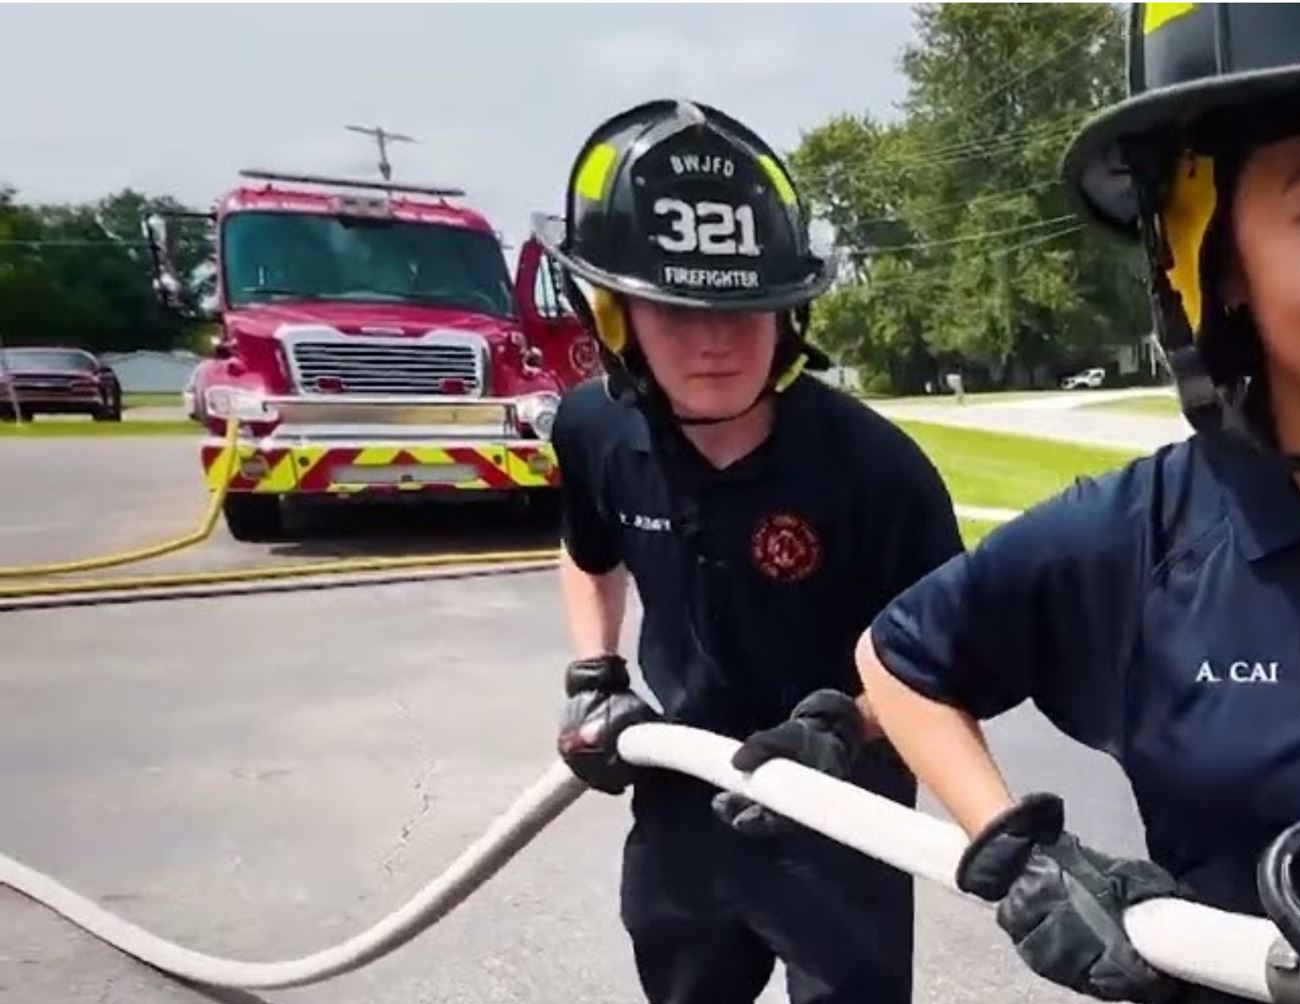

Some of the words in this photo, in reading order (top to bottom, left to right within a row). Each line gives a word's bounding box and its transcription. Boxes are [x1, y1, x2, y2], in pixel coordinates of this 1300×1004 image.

[653, 198, 760, 257] 321
[664, 266, 760, 288] FIREFIGHTER
[1230, 661, 1279, 683] CAI
